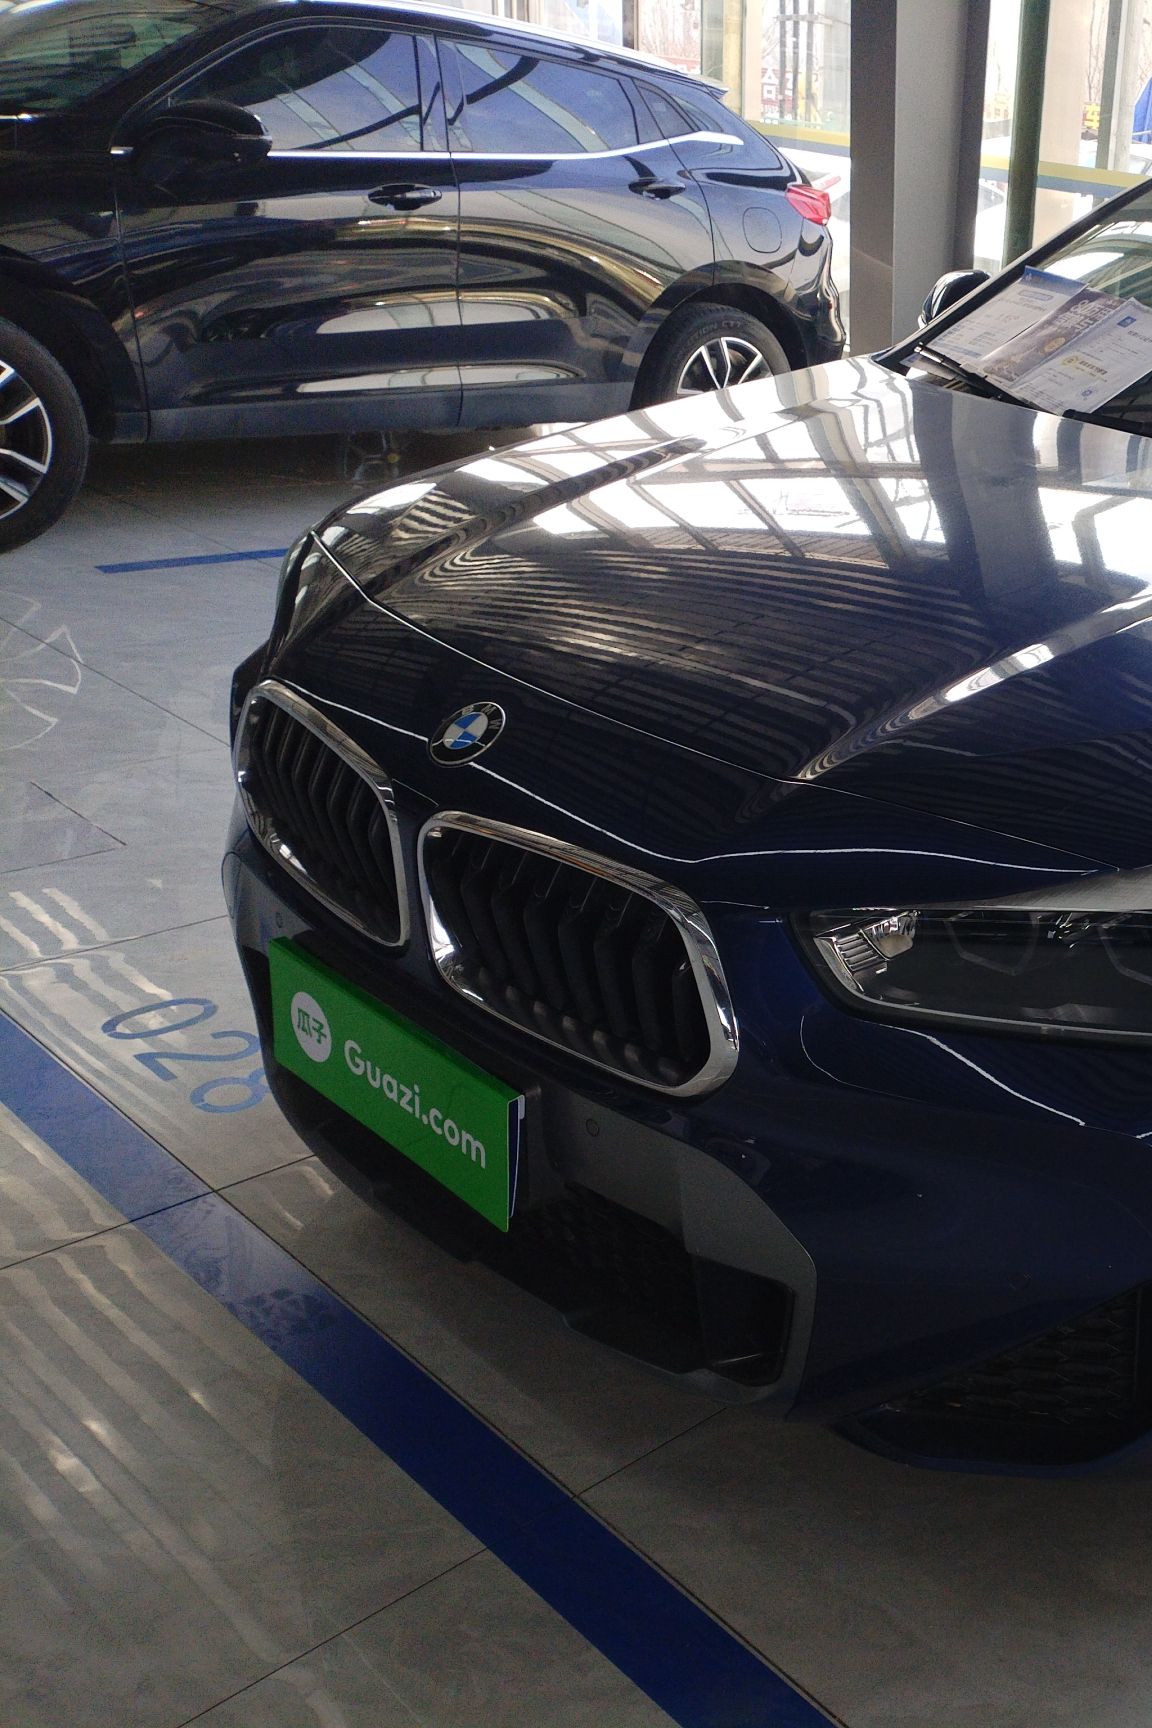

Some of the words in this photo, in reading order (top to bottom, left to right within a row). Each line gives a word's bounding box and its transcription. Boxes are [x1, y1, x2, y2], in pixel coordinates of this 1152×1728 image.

[461, 701, 503, 731] BMW
[296, 1007, 328, 1046] 瓜子
[343, 1038, 487, 1170] Guazi.com
